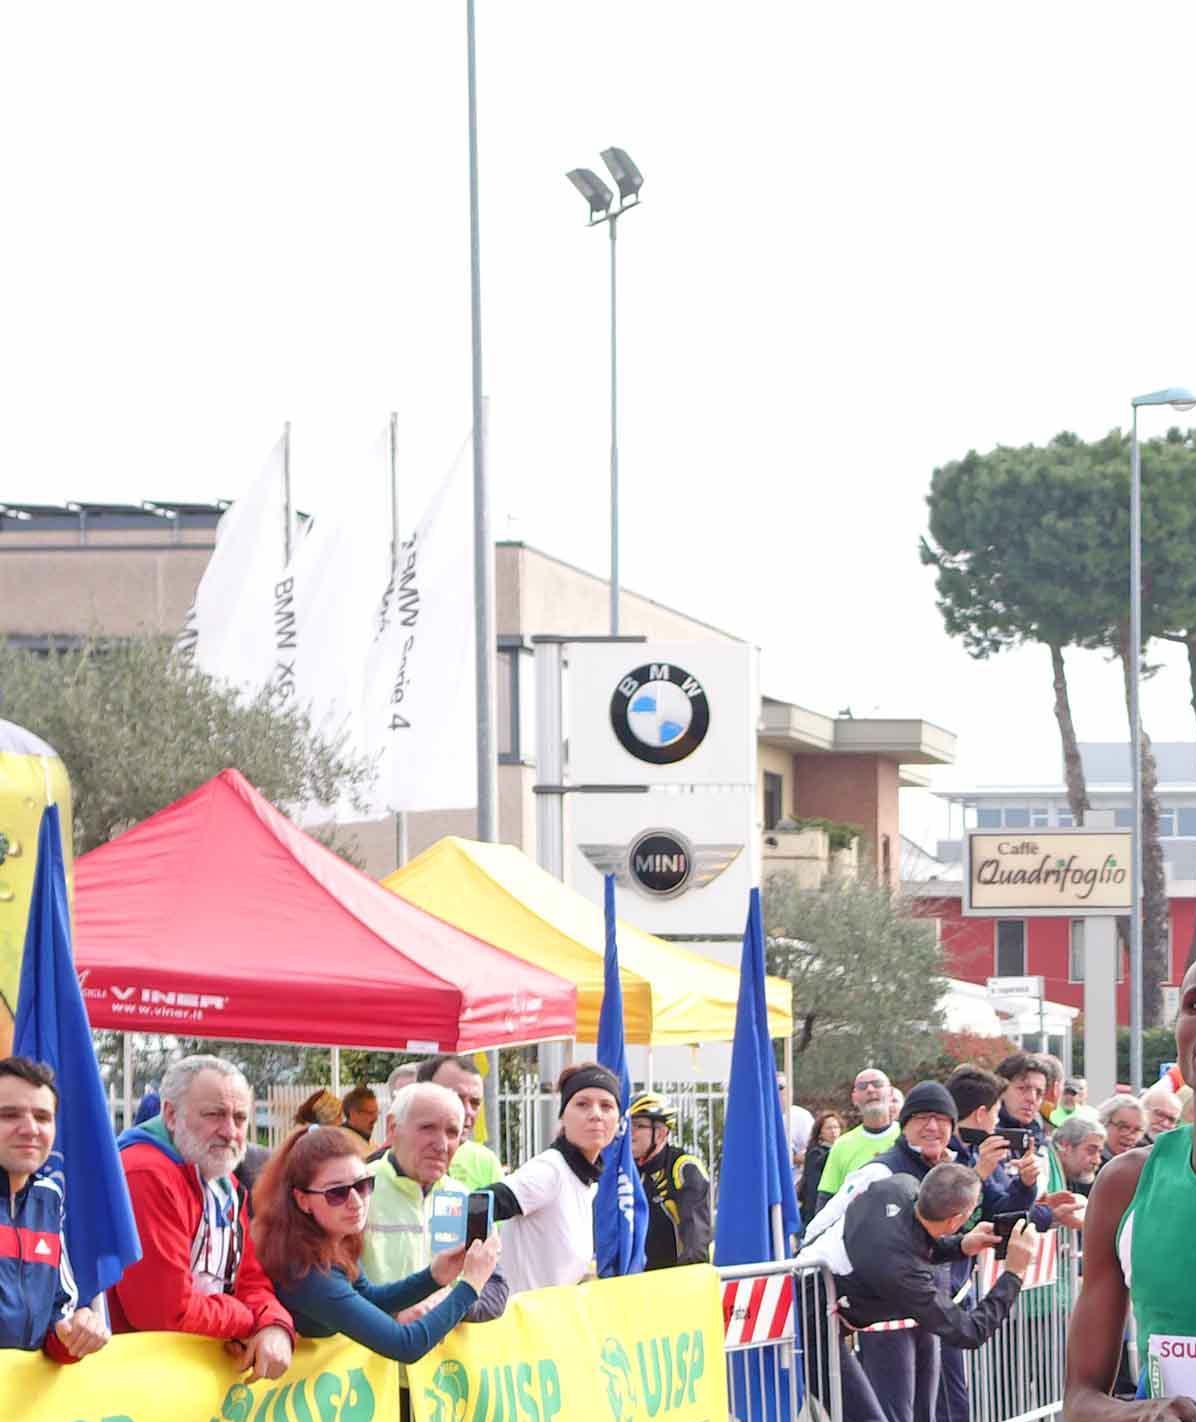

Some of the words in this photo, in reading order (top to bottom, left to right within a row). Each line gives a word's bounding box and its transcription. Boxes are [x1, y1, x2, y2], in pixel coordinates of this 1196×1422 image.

[274, 576, 297, 649] BMW
[619, 664, 702, 698] BMW
[388, 713, 411, 731] 4
[635, 853, 685, 873] MINI
[976, 854, 1127, 900] Quadrifoglio
[636, 1329, 704, 1418] UISP
